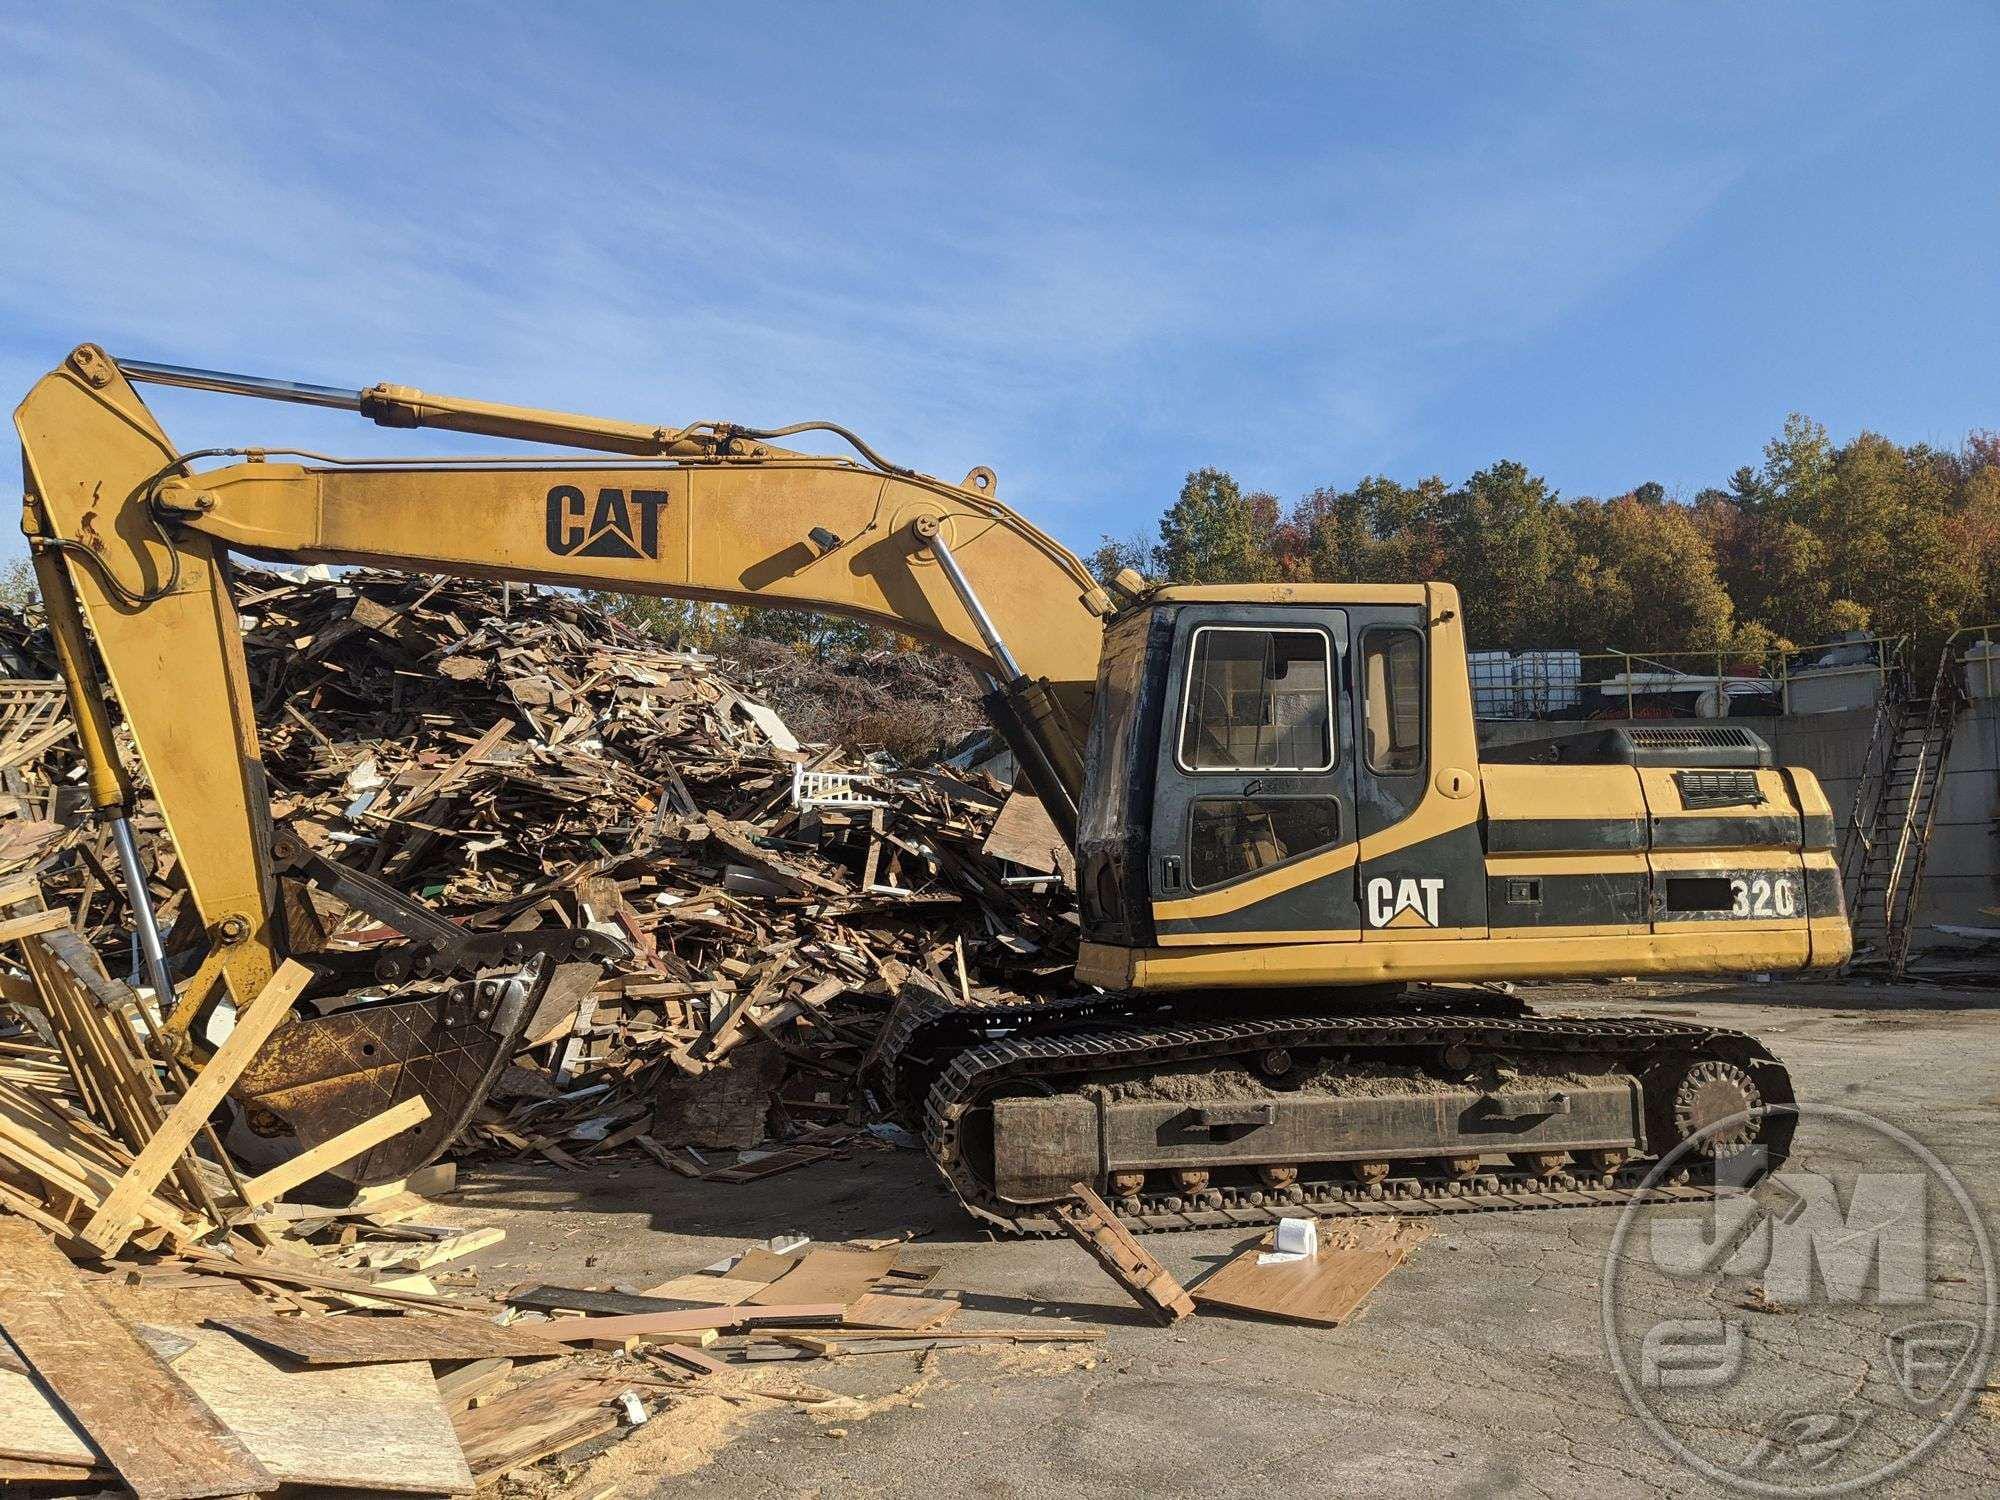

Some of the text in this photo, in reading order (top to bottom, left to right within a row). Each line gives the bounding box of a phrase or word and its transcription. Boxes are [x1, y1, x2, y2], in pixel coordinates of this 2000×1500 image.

[546, 485, 669, 559] CAT
[1368, 878, 1444, 928] CAT
[1731, 879, 1793, 916] 320
